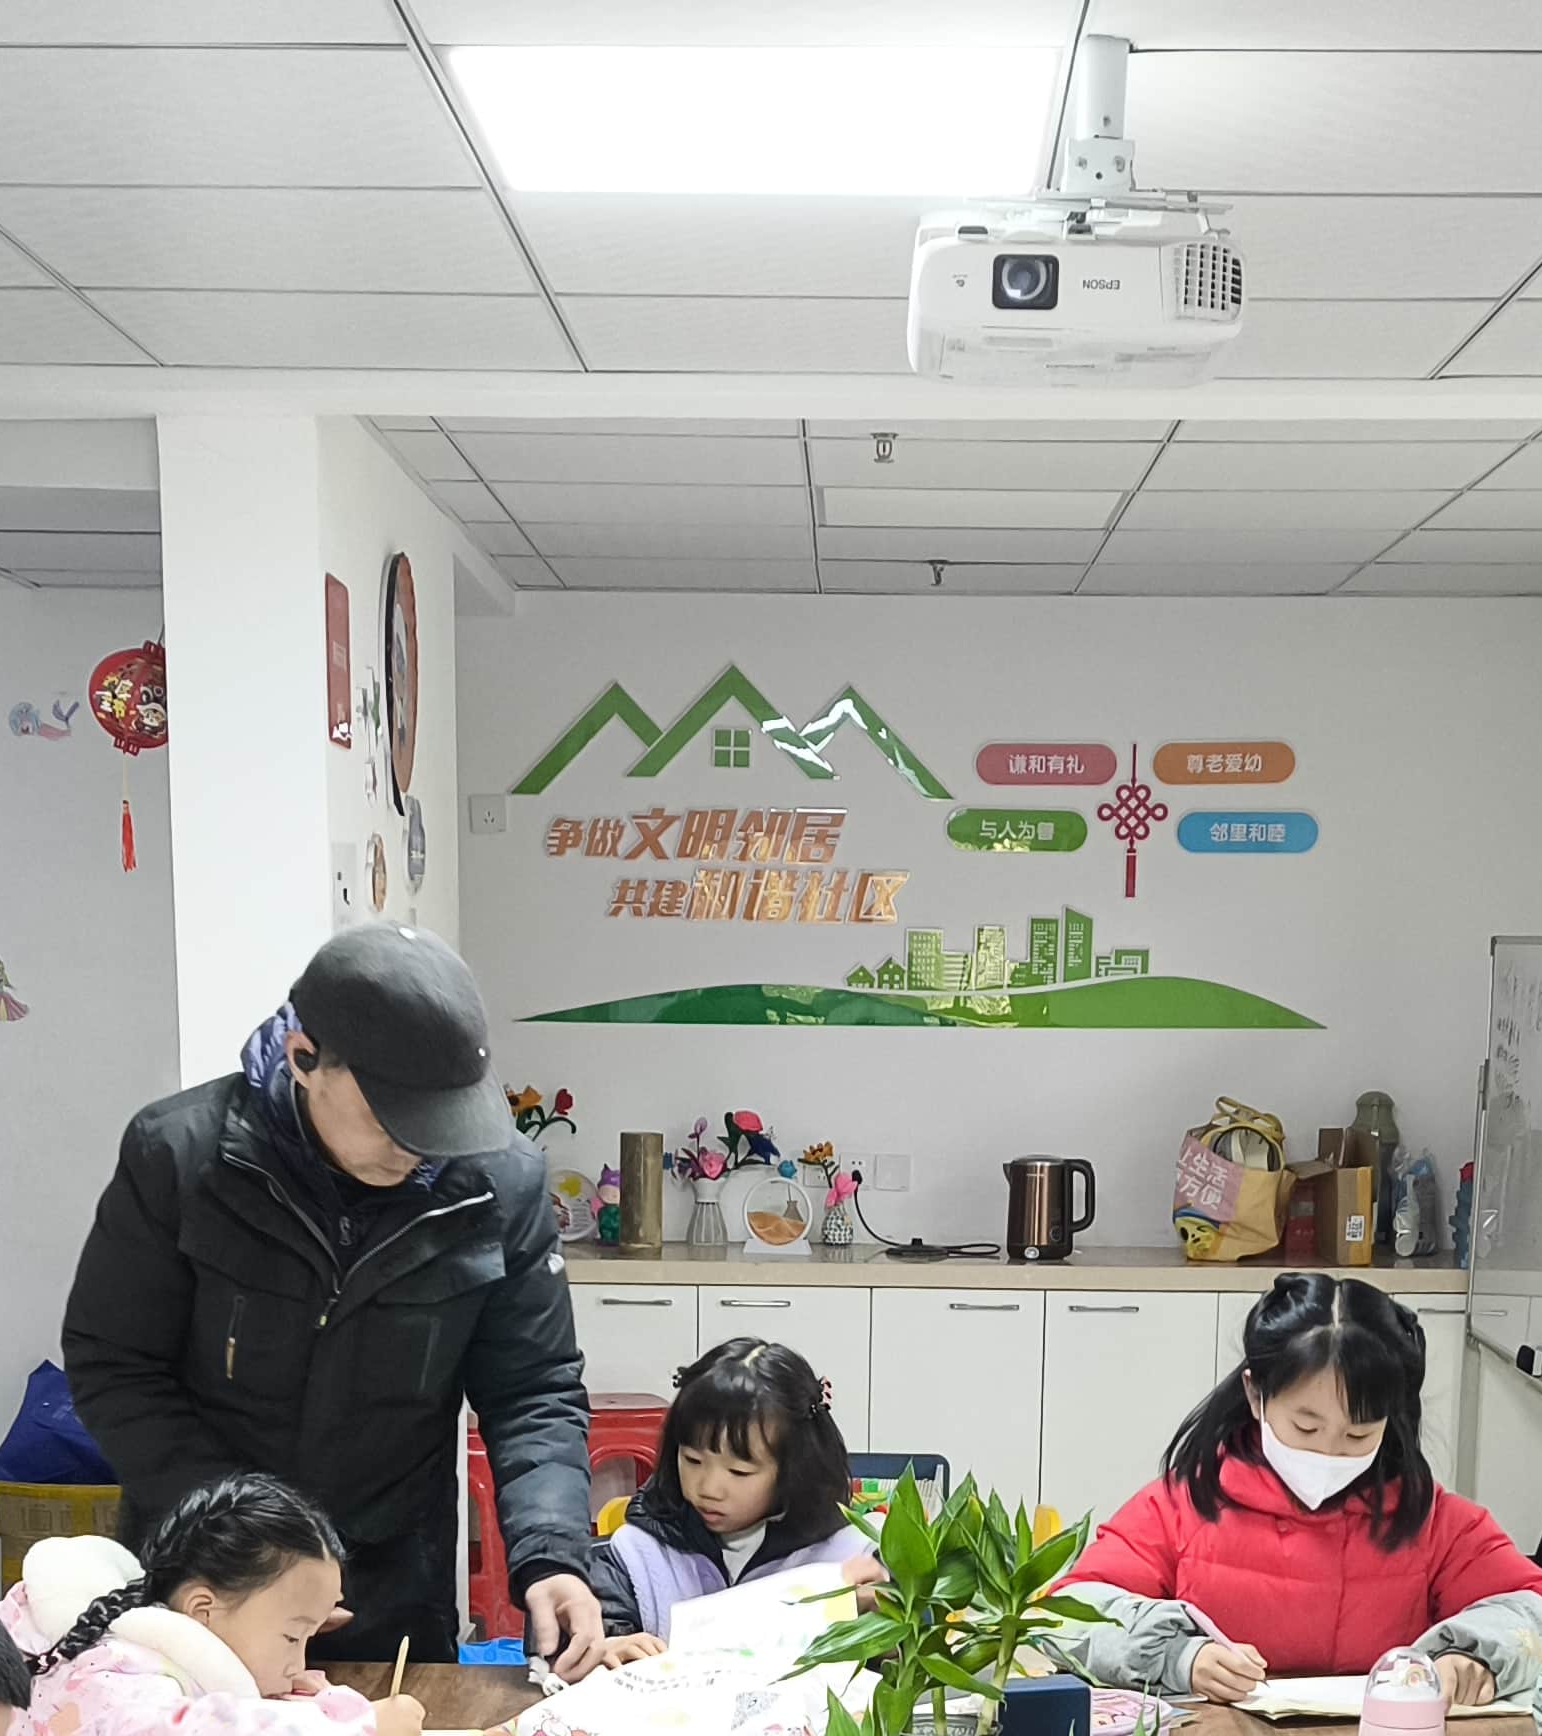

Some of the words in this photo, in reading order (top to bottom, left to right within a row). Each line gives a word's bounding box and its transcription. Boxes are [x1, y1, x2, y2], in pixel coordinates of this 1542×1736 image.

[1082, 279, 1121, 290] EPSON
[1008, 753, 1085, 775] 谦和有礼
[1187, 752, 1262, 774] 尊老爱幼
[546, 807, 849, 864] 争做文明邻居
[979, 820, 1055, 841] 与人为善
[1209, 823, 1286, 843] 邻里和睦
[608, 868, 911, 923] 共建和谐社区
